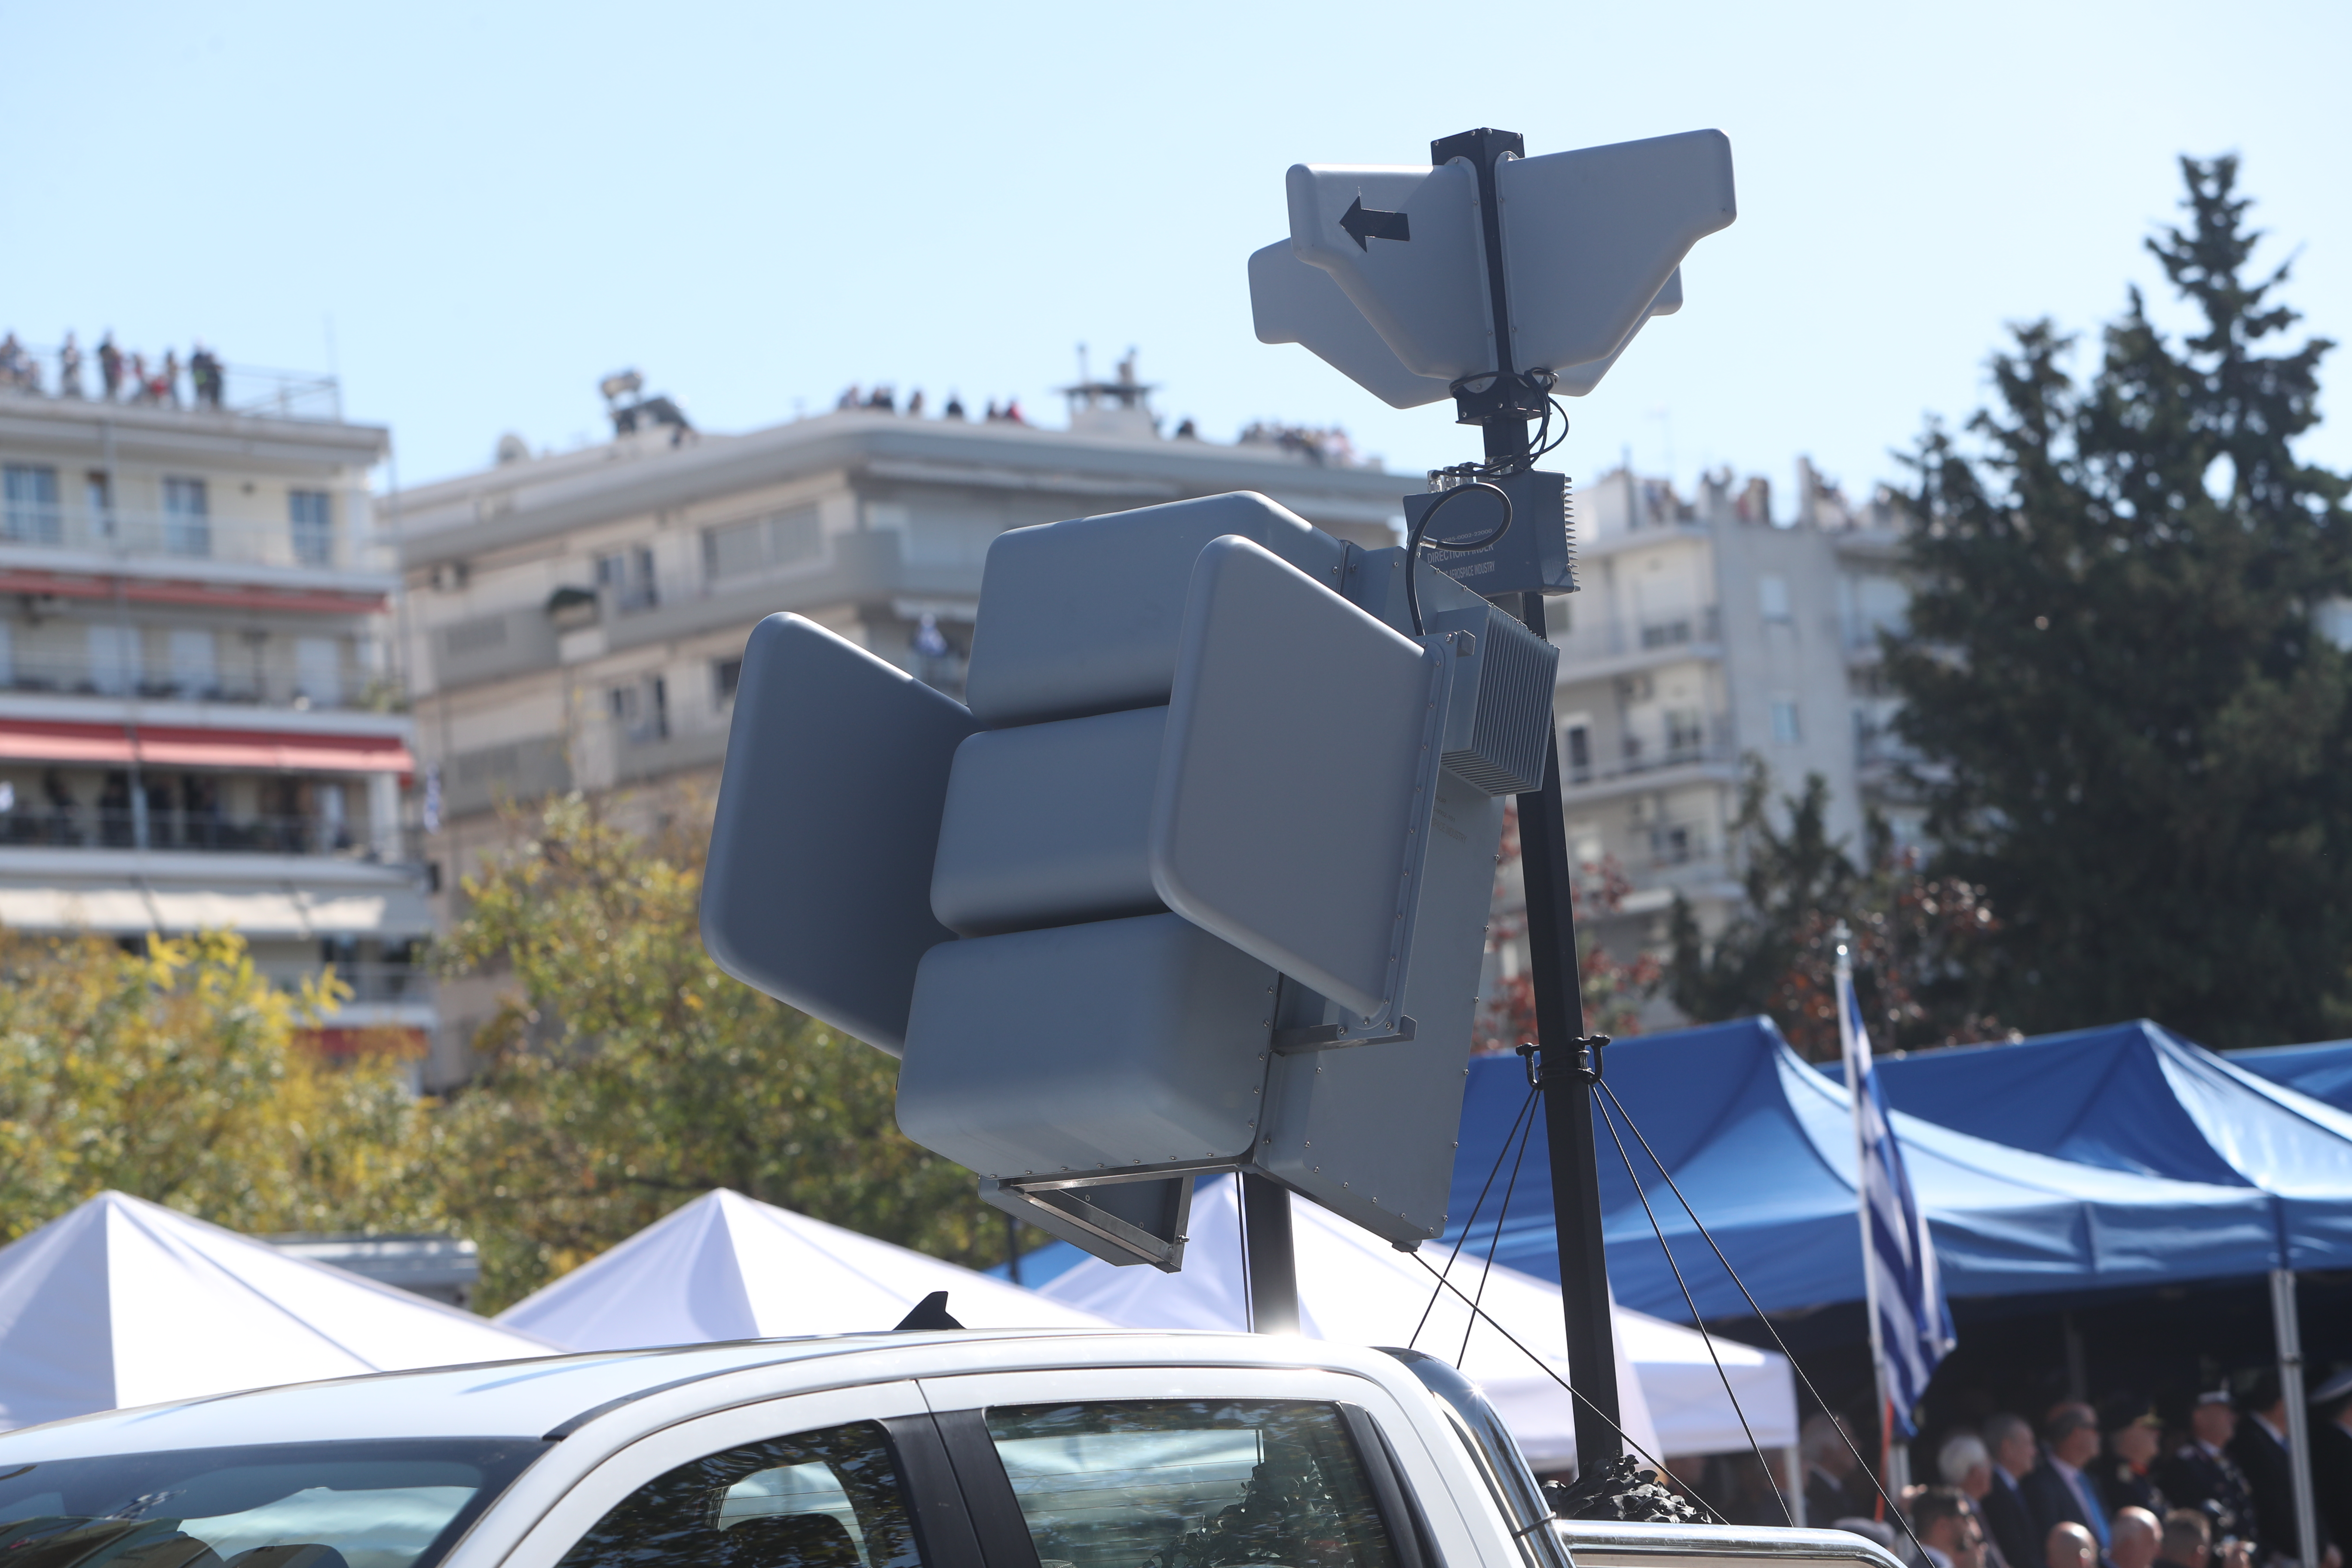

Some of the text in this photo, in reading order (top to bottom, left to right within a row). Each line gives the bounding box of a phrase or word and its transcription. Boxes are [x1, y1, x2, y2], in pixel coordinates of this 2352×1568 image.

[1449, 561, 1495, 579] AEROSPACE INDUSTRY
[1435, 793, 1446, 804] AUR
